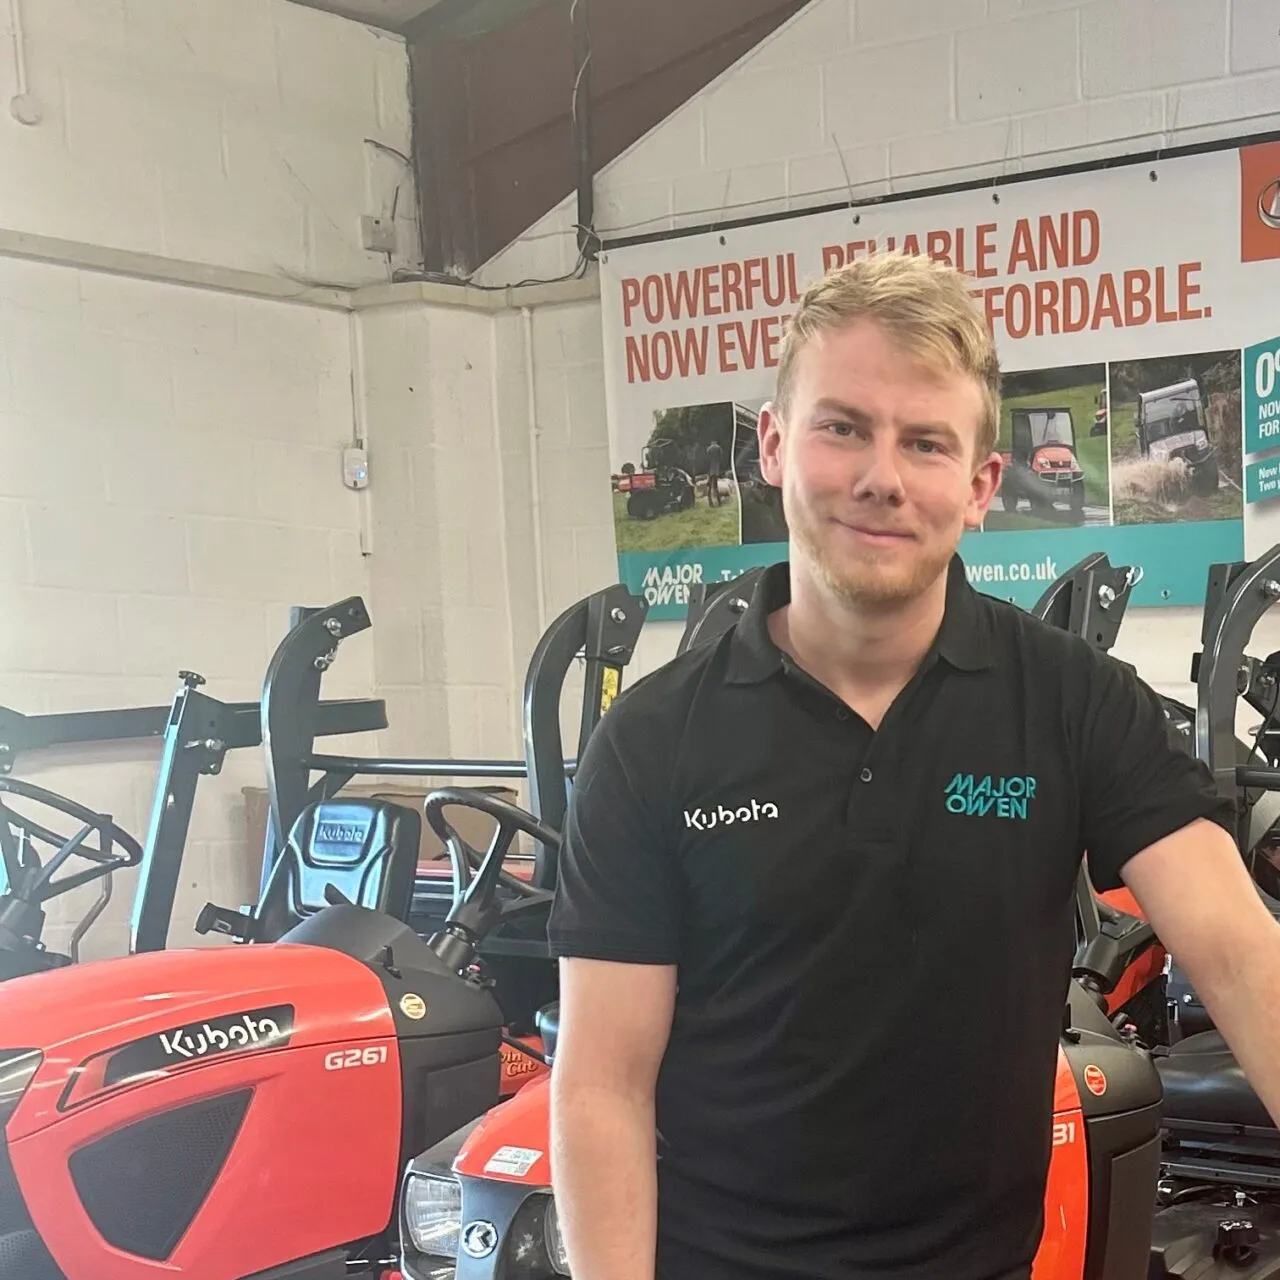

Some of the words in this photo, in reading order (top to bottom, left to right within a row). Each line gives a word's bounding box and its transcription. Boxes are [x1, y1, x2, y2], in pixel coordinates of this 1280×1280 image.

[1007, 209, 1100, 274] AND
[625, 326, 709, 383] NOW
[717, 315, 792, 373] EVE
[1259, 419, 1280, 439] FOR
[1259, 477, 1276, 493] Two
[642, 564, 703, 587] MAJOR
[966, 556, 1058, 582] wen.co.uk
[944, 772, 1036, 799] MAJOR
[684, 799, 778, 830] Kubota
[945, 794, 1027, 819] OWEN
[159, 1015, 280, 1057] Kubota
[325, 1046, 388, 1071] G261
[1052, 1121, 1075, 1146] 31
